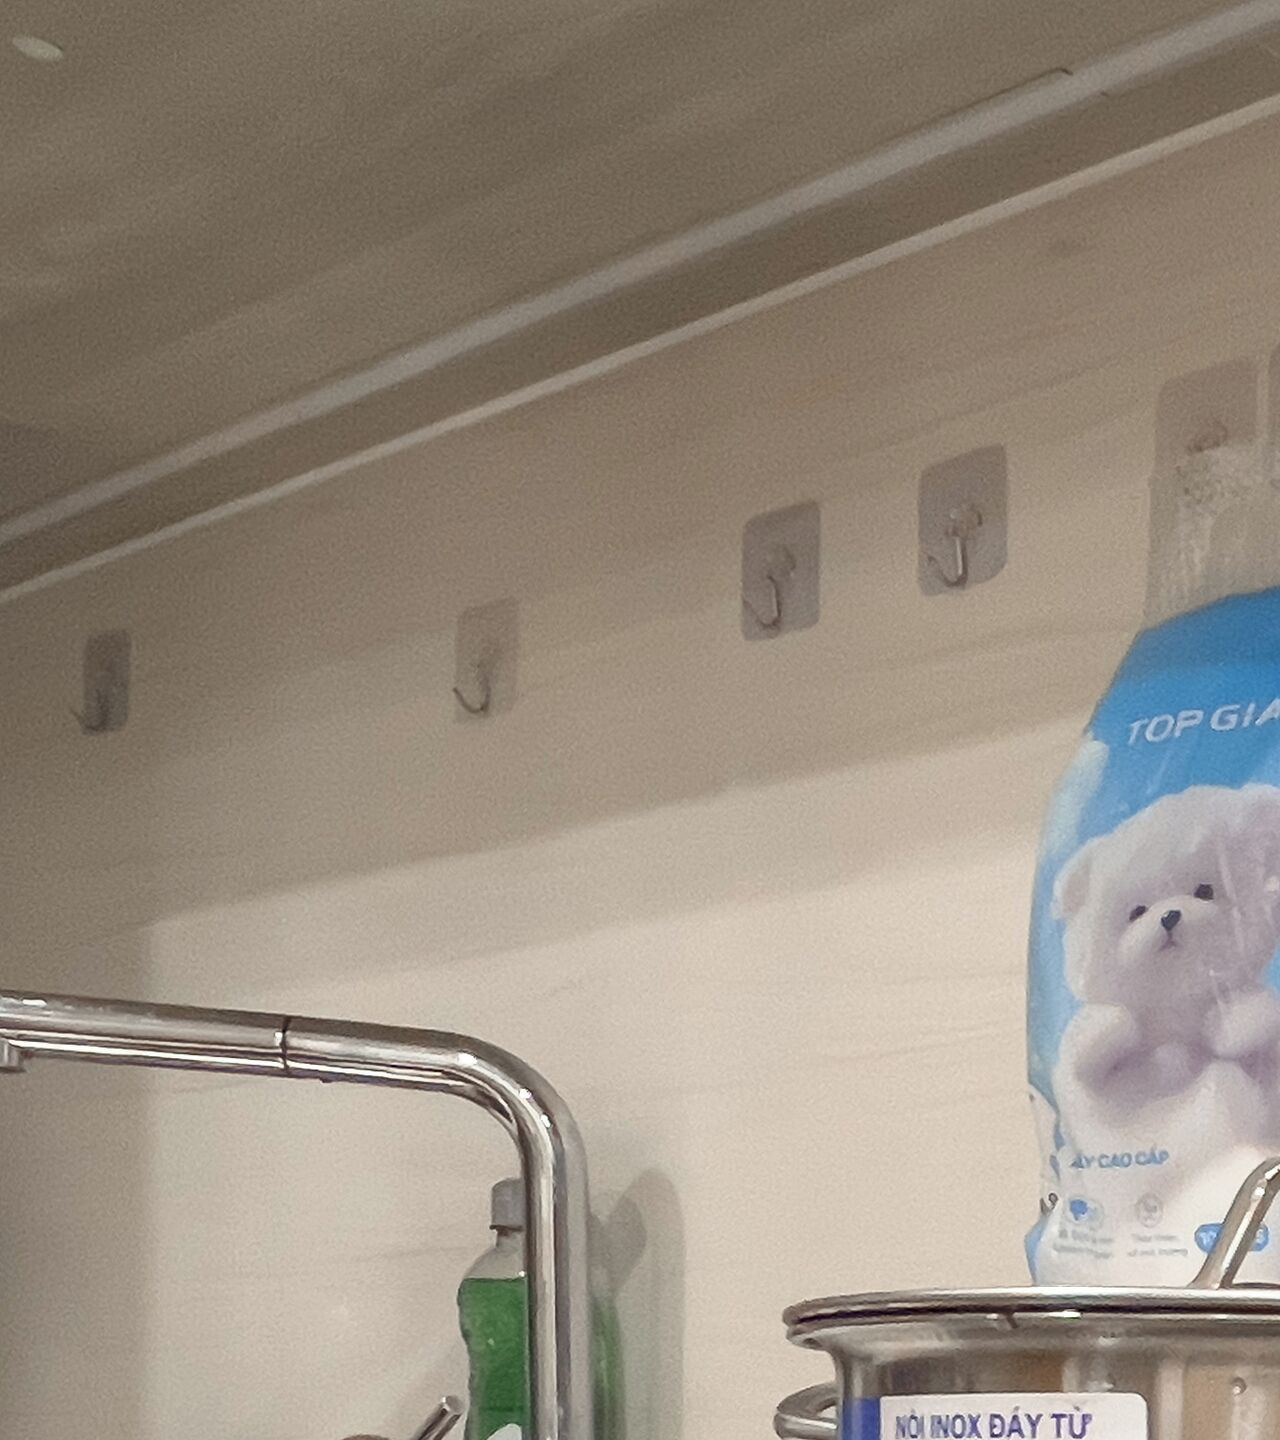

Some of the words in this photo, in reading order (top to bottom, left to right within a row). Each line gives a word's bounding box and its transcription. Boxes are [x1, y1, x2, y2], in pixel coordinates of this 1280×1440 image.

[1127, 709, 1205, 746] TOP
[929, 1413, 983, 1440] INOX
[988, 1405, 1045, 1440] ĐÁY
[1050, 1404, 1094, 1440] TỪ
